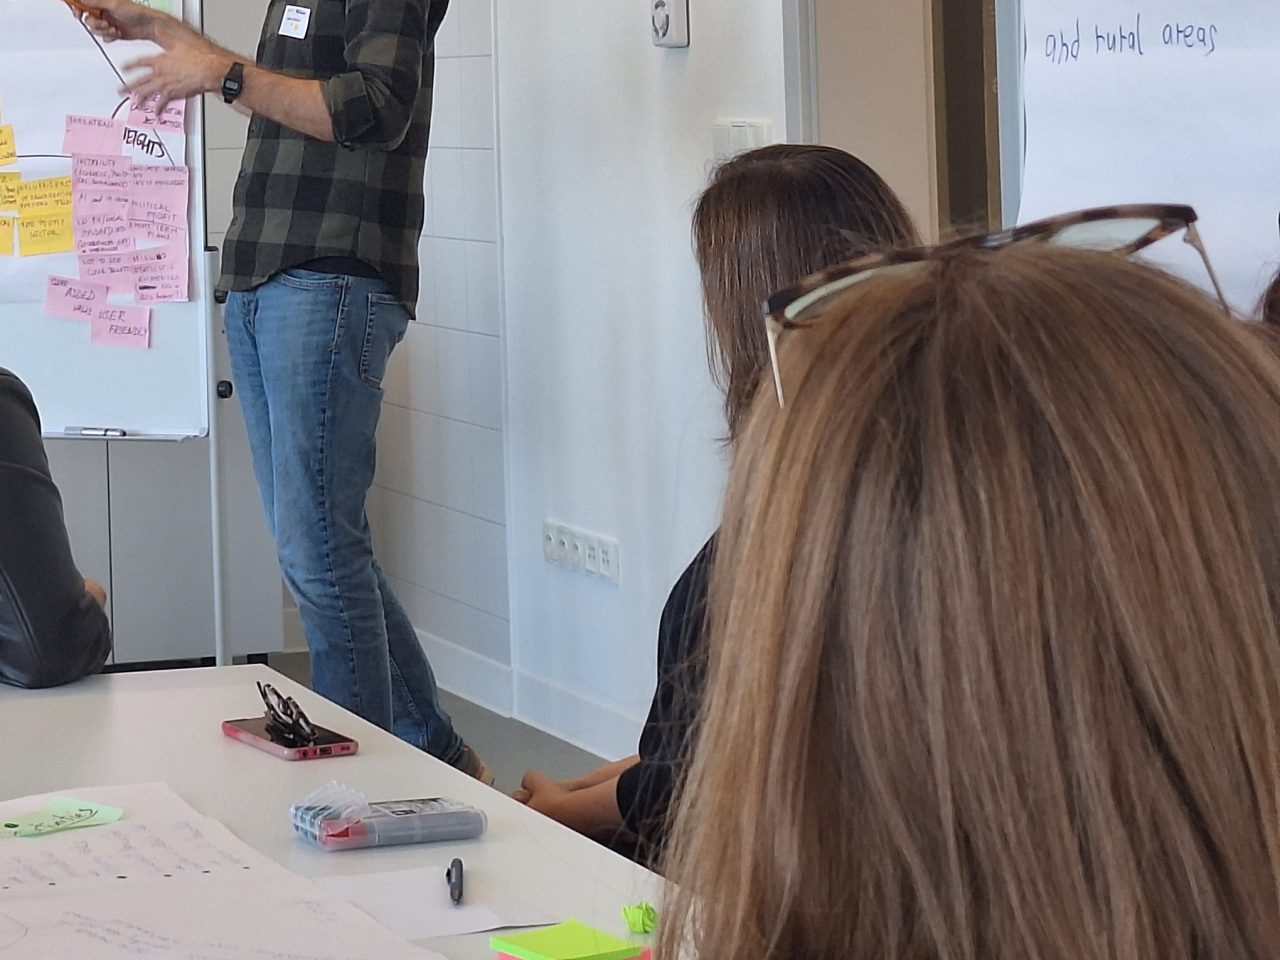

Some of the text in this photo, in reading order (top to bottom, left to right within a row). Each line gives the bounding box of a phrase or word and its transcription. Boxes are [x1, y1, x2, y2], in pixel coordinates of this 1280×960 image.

[1045, 13, 1218, 64] and rural areas
[99, 310, 126, 322] USER
[109, 324, 148, 337] FRIENDLY
